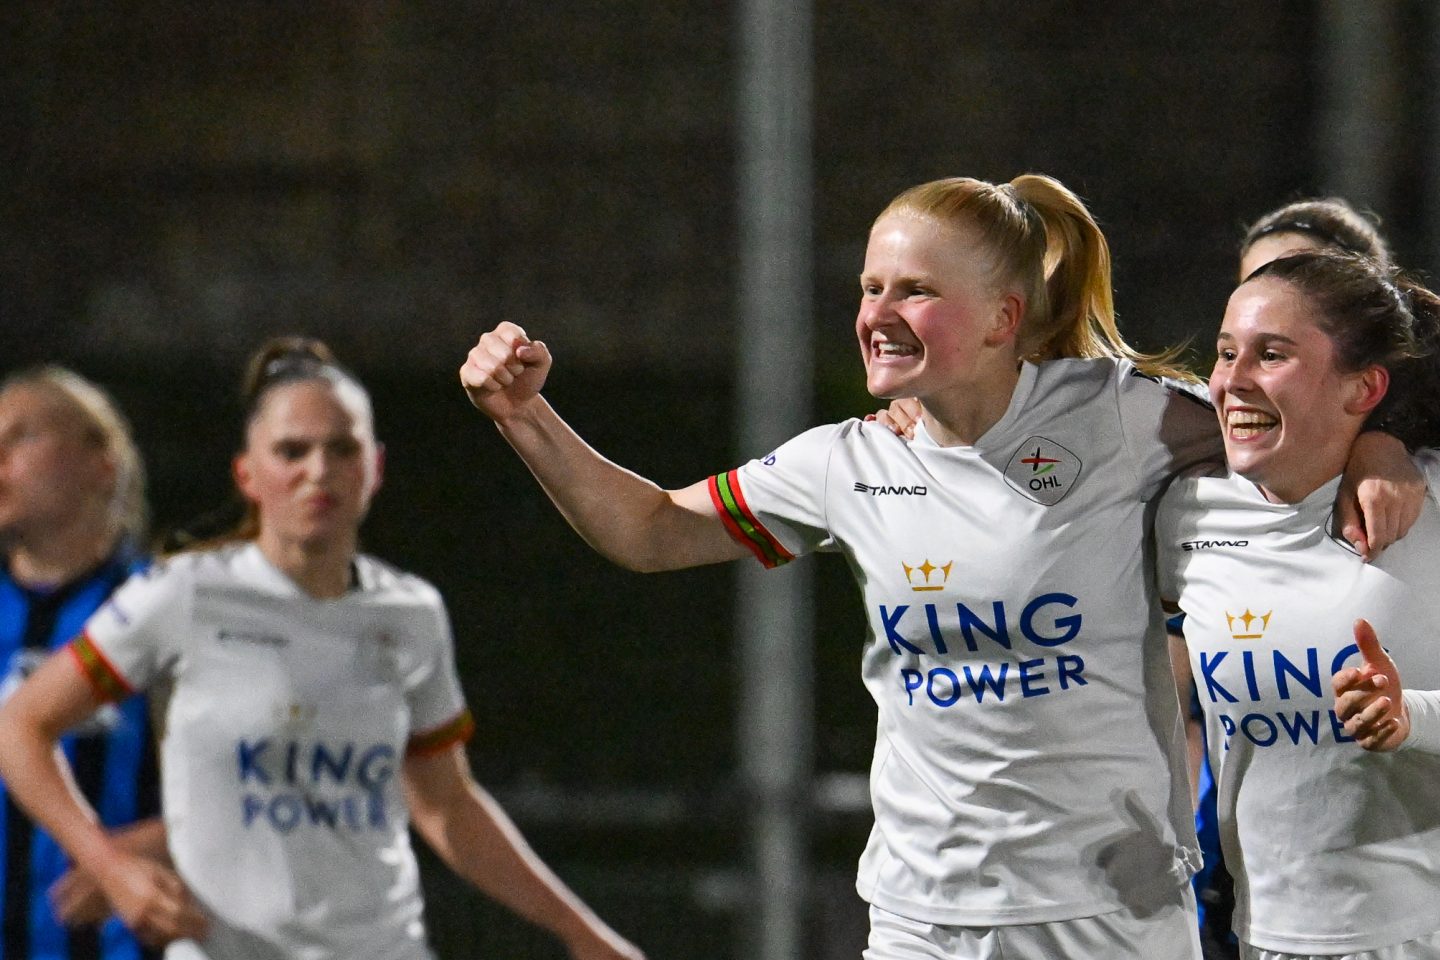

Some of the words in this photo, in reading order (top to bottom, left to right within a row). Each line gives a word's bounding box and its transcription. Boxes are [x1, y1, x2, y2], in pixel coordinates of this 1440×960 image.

[854, 482, 927, 496] STANNO
[1029, 475, 1062, 492] OHL
[1181, 541, 1249, 552] STANNO
[879, 593, 1082, 655] KING
[901, 654, 1088, 707] POWER
[1219, 709, 1357, 751] POWE
[236, 738, 395, 786] KING
